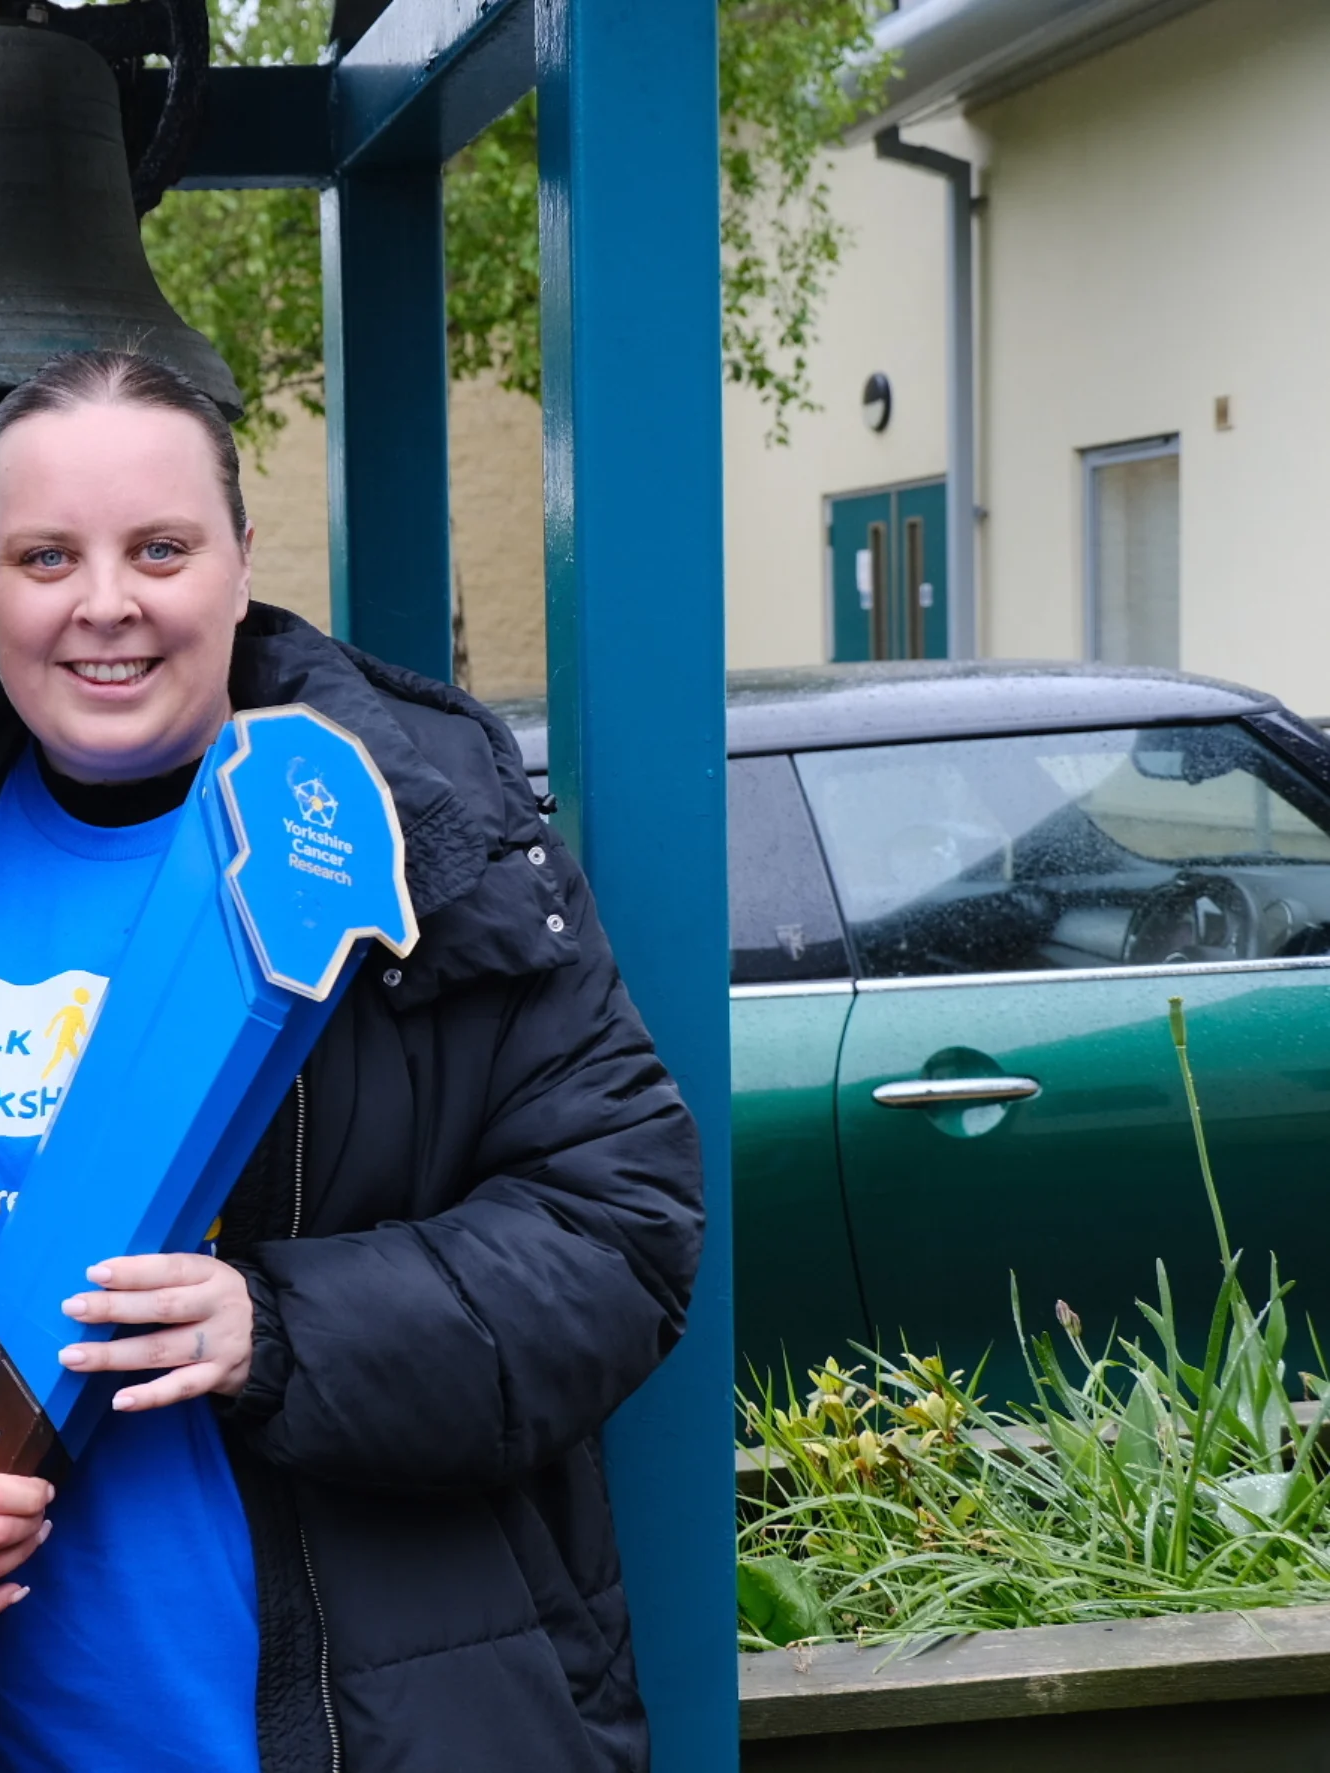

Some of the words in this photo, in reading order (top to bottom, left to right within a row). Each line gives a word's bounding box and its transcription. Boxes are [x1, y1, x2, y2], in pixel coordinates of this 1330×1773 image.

[282, 817, 353, 854] Yorkshire
[292, 838, 345, 867] Cancer
[288, 853, 352, 887] Research
